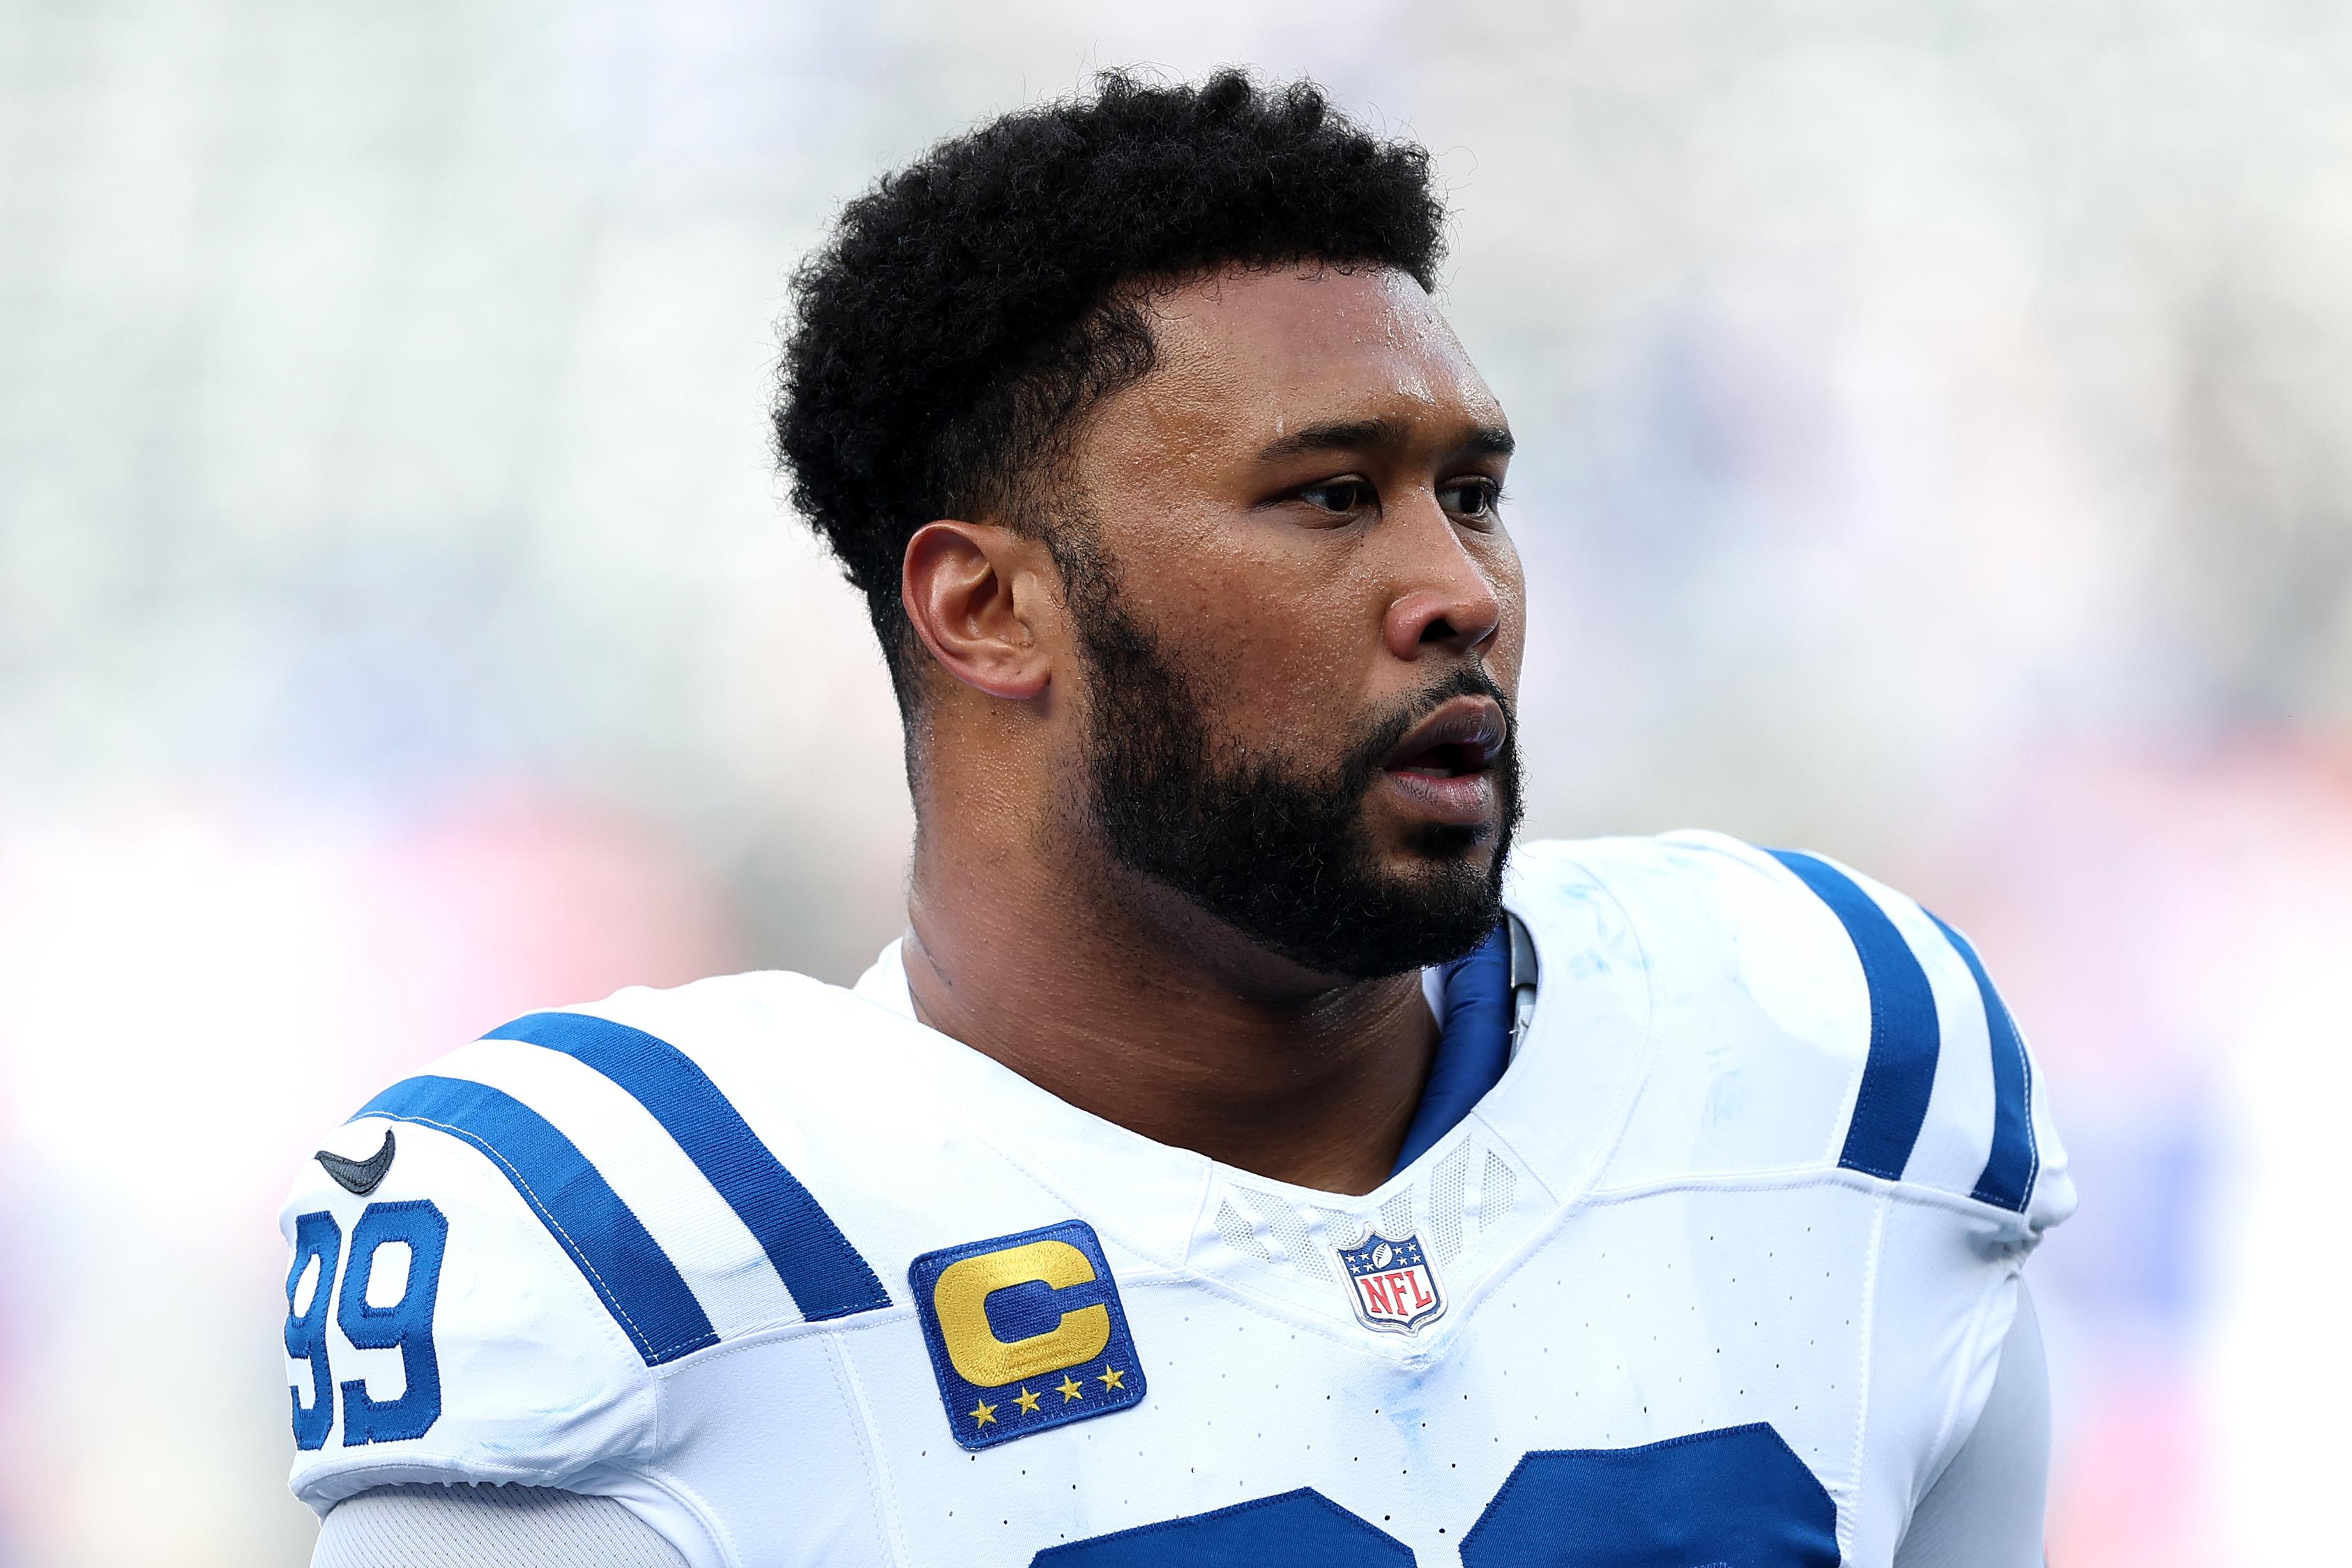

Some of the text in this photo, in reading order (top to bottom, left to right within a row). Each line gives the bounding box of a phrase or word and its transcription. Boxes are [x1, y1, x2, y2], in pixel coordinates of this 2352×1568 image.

[285, 1198, 448, 1450] 99
[934, 1240, 1111, 1387] C
[1360, 1270, 1432, 1316] NFL
